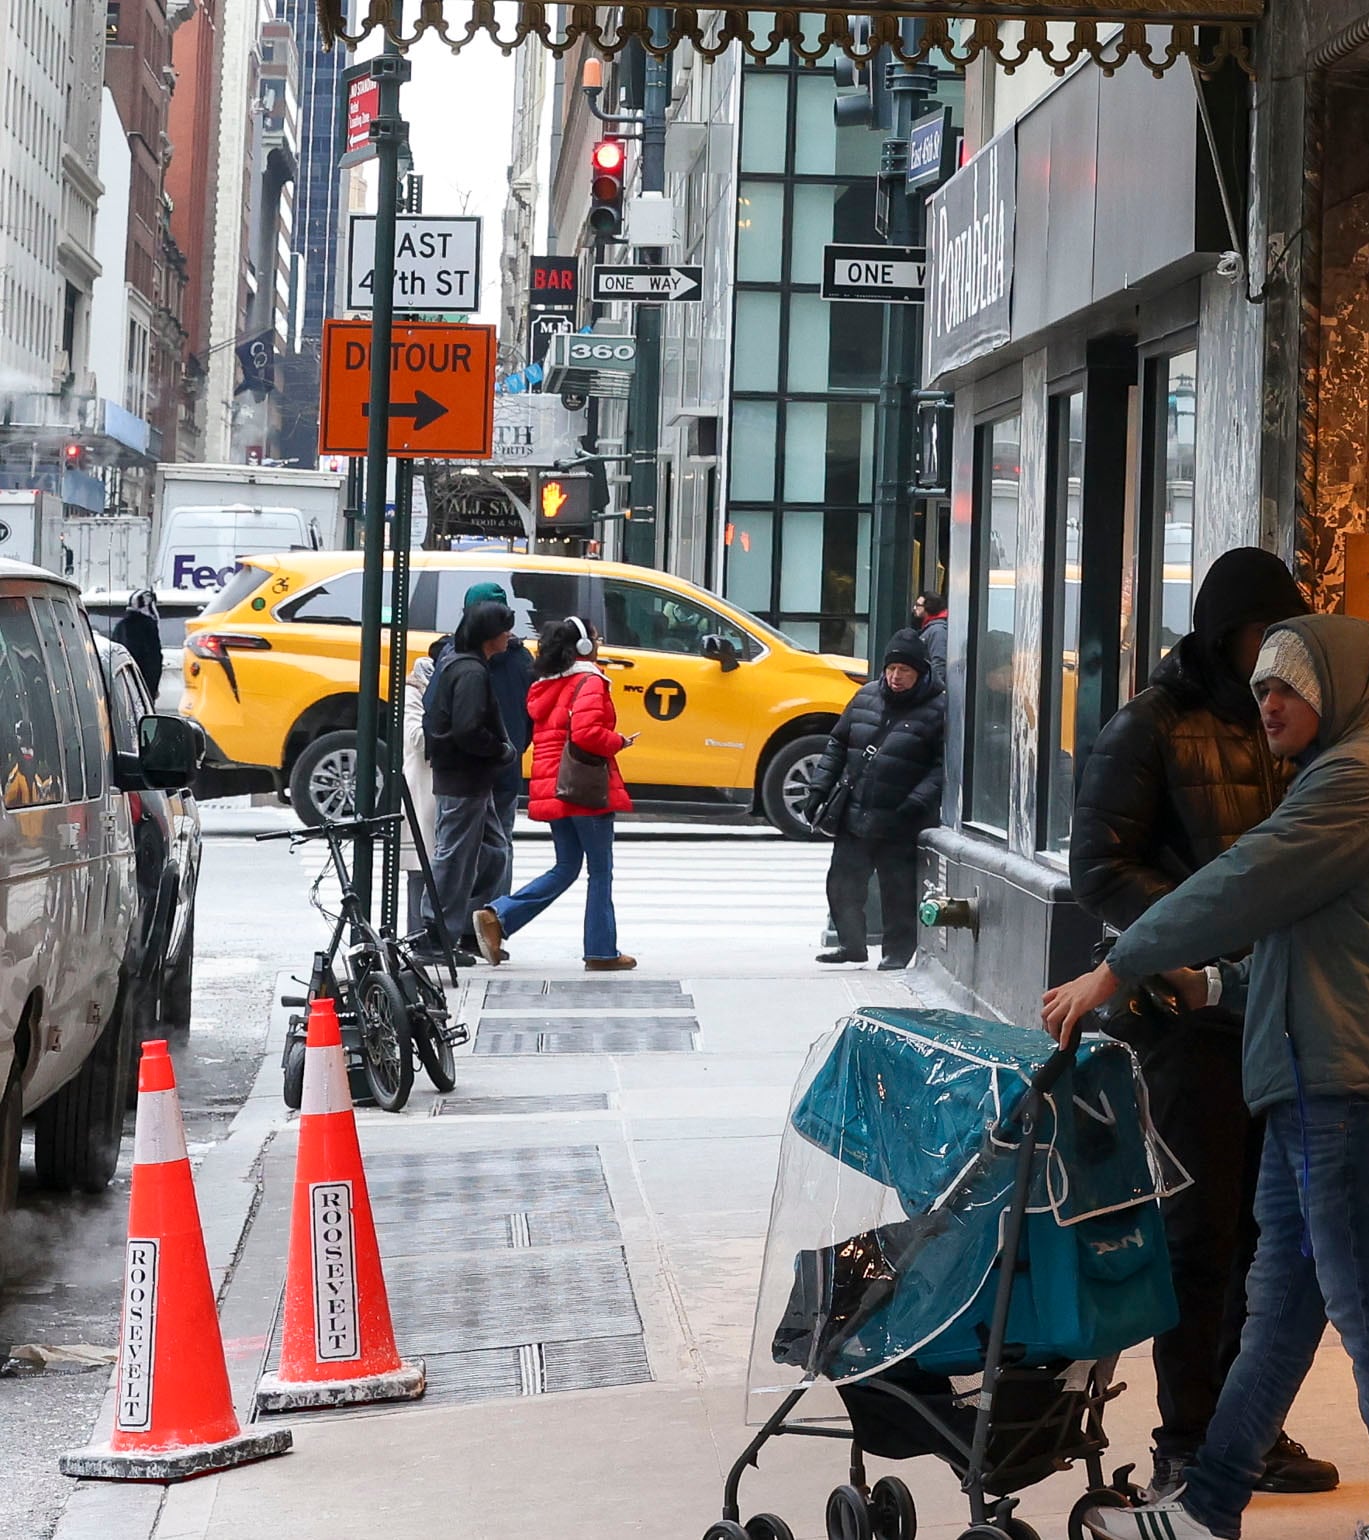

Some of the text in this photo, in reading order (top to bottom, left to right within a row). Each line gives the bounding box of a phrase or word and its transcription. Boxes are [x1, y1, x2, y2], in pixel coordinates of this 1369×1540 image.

[911, 141, 923, 170] East
[933, 130, 940, 160] St
[396, 232, 453, 258] AST
[358, 269, 470, 296] 4th ST
[534, 268, 574, 290] BAR
[605, 277, 682, 291] ONE WAY
[848, 263, 894, 284] ONE
[345, 341, 472, 373] DTOUR
[570, 344, 636, 360] 360
[624, 685, 678, 716] NYC T
[321, 1192, 347, 1350] ROOSEVELT
[125, 1249, 146, 1418] ROOSEVELT
